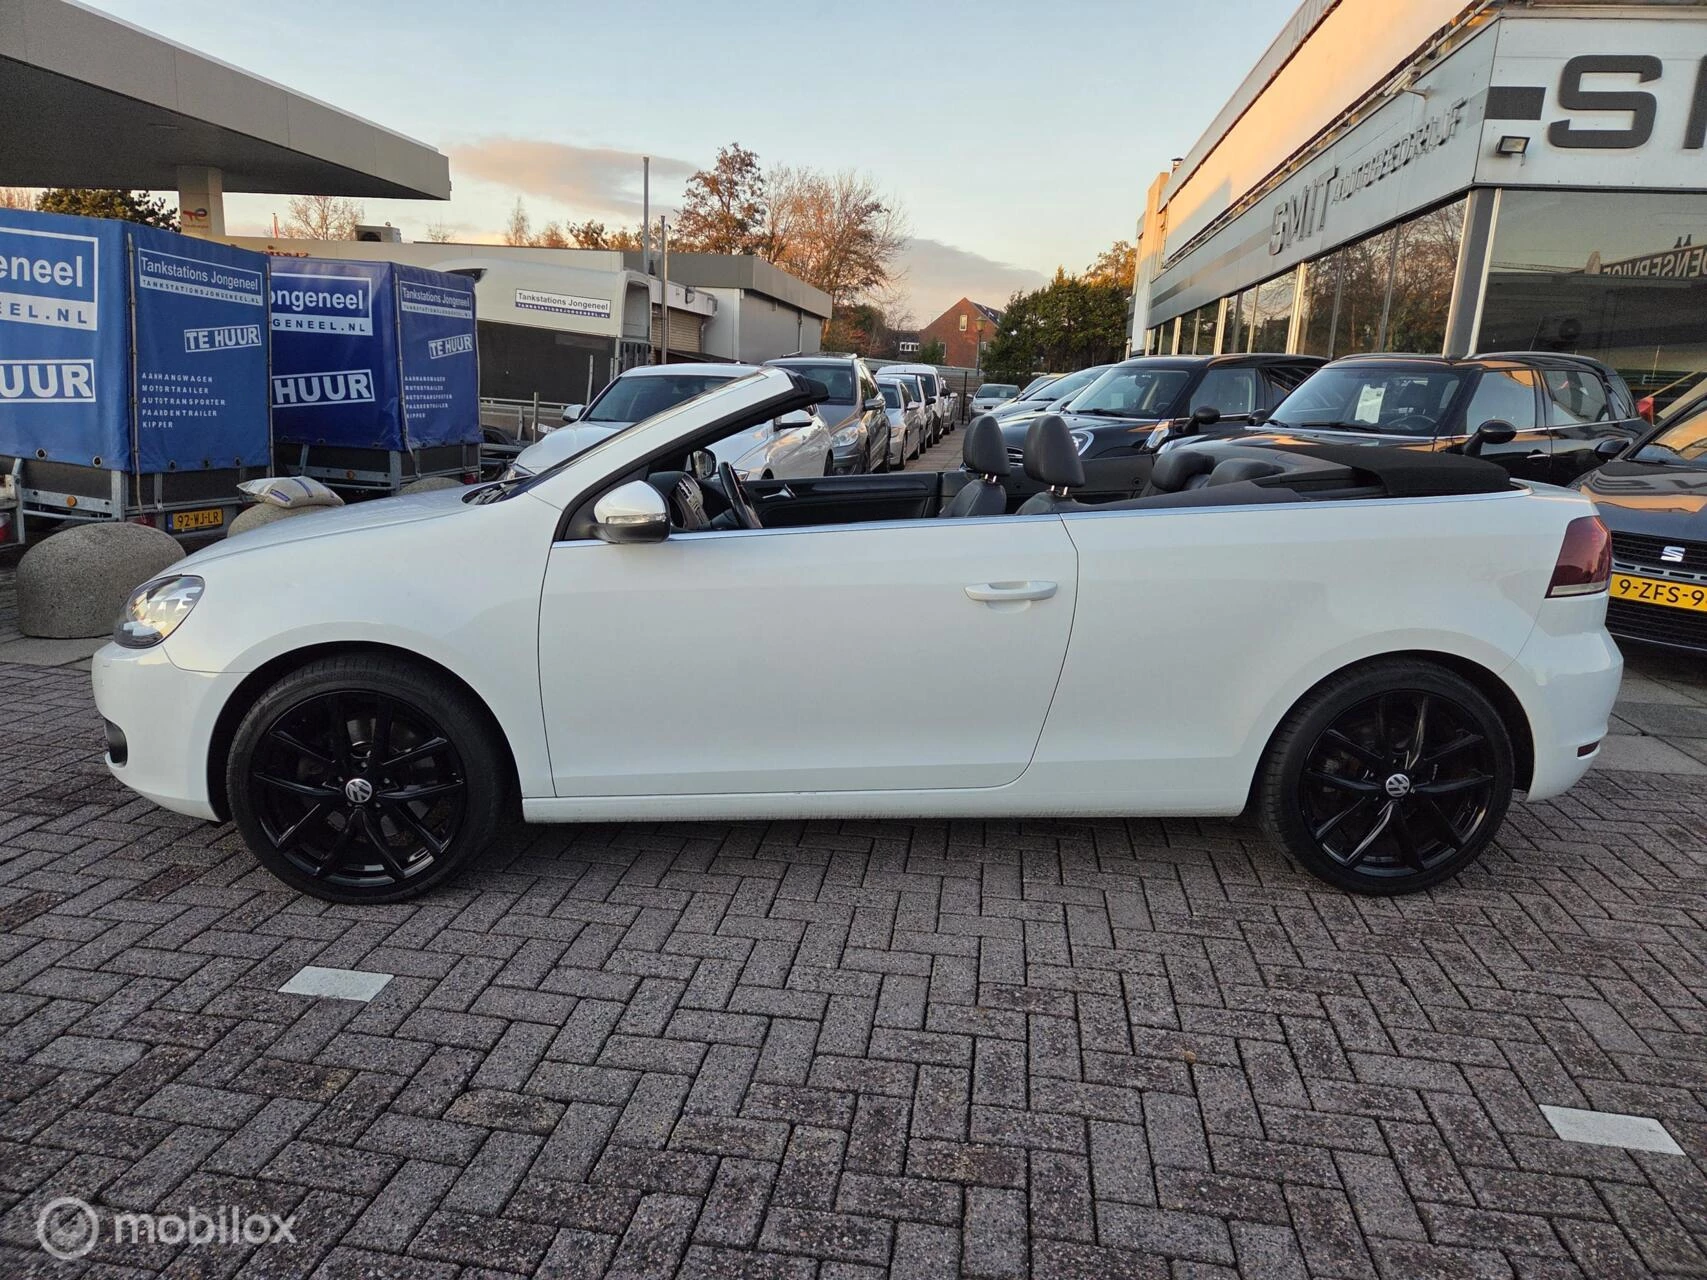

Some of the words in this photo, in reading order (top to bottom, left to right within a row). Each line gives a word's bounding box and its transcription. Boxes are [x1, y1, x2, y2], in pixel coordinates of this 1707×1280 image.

[1548, 54, 1707, 150] S
[1269, 165, 1340, 256] SMIT
[141, 256, 209, 282] Tankstations
[211, 271, 258, 291] Jongeneel
[402, 287, 441, 302] Tankstations
[518, 292, 567, 306] Tankstations
[568, 299, 608, 310] Jongeneel
[0, 302, 87, 324] EL.NL
[272, 318, 365, 332] GENEEL.NL
[186, 331, 210, 350] TE
[214, 327, 259, 347] HUUR
[430, 341, 444, 357] TE
[445, 336, 473, 352] HUUR
[0, 365, 92, 398] UUR
[142, 372, 213, 383] AANHANGWAGEN
[142, 384, 209, 394] MOTORTRAILER
[274, 373, 372, 404] HUUR
[142, 397, 226, 406] AUTOTRANSPORTER
[142, 409, 217, 417] PAARDENTRAILER
[142, 421, 173, 429] KIPPER
[177, 511, 219, 528] 92-WJ-LR
[1619, 578, 1707, 607] 9-ZFS-9
